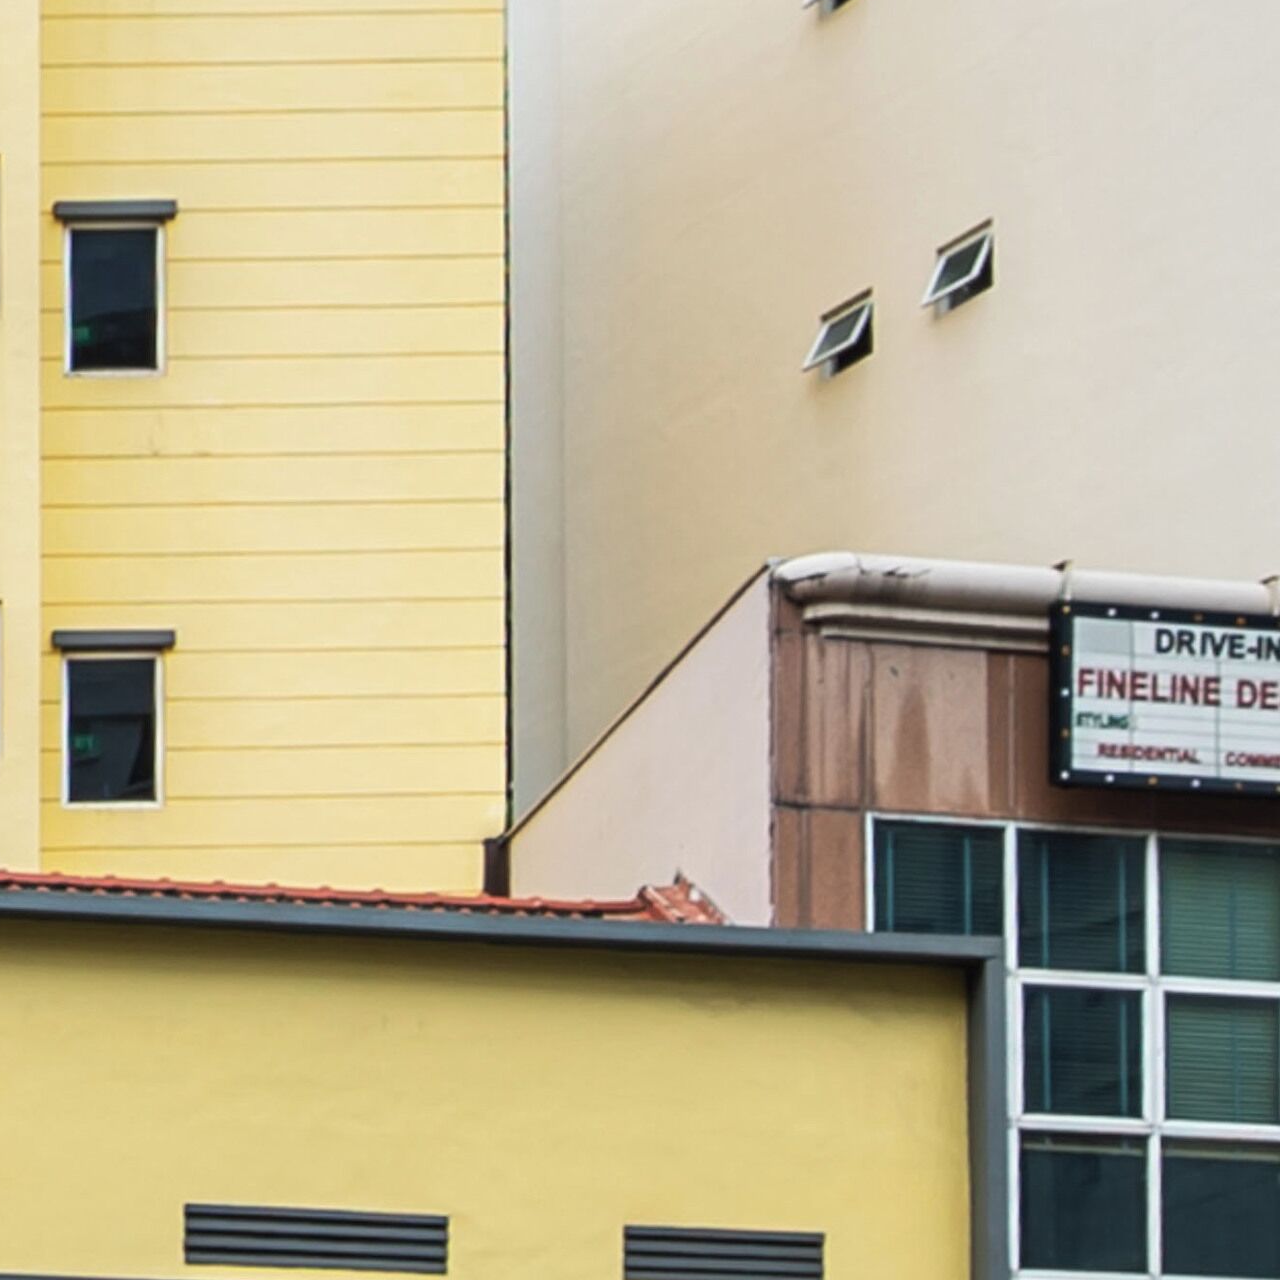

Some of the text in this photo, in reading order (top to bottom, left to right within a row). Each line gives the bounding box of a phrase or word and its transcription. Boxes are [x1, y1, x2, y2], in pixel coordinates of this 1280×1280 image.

[1155, 628, 1280, 661] DRIVE-IN
[1078, 667, 1280, 710] FINELINE DE
[1098, 742, 1202, 765] RESIDENTIAL
